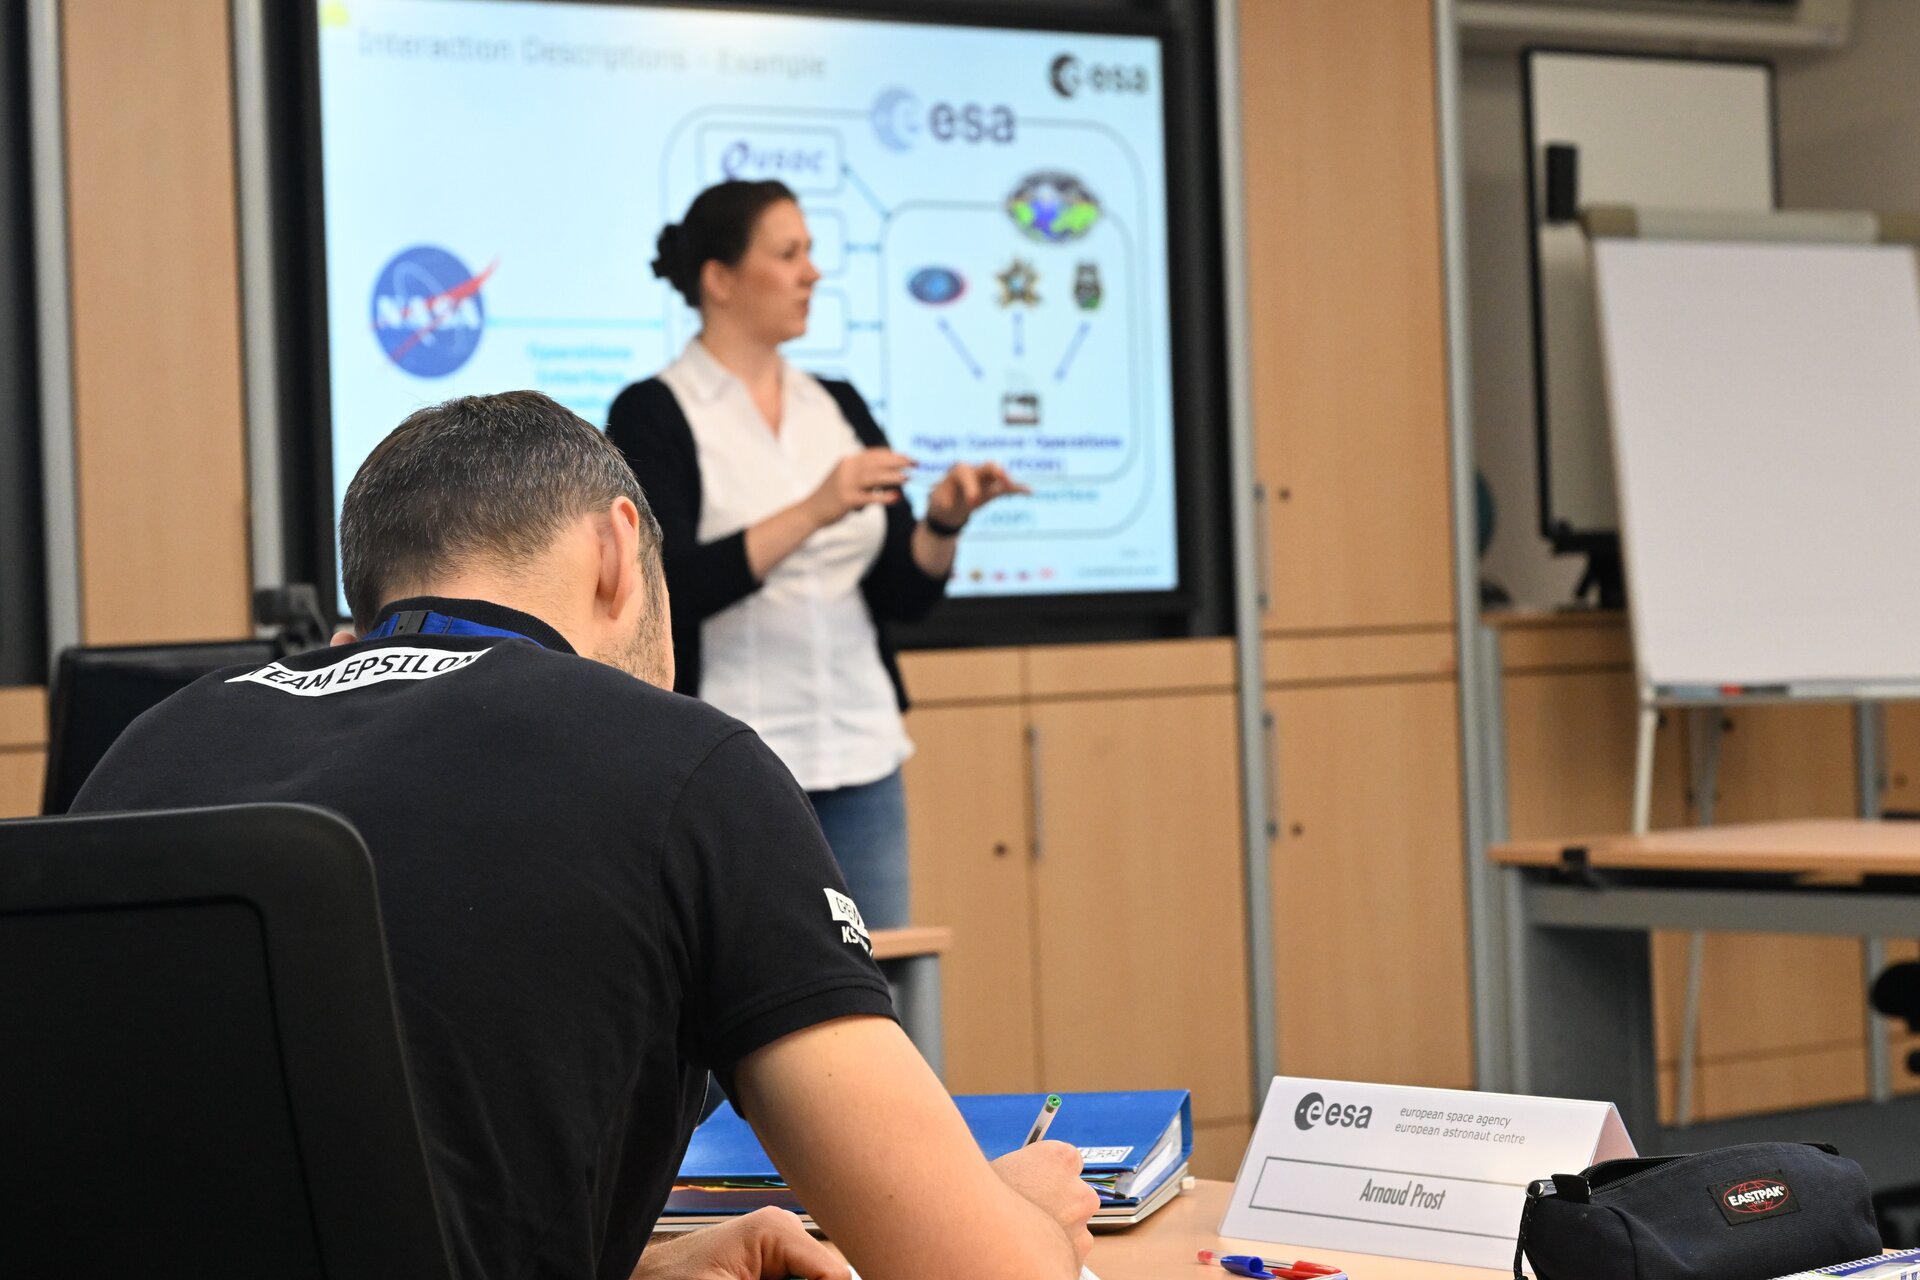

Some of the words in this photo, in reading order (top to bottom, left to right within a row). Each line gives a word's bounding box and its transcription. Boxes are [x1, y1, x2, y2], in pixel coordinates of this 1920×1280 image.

[1088, 66, 1148, 93] esa
[926, 102, 1017, 143] esa
[377, 293, 482, 331] NASA
[249, 664, 336, 690] TEAM
[337, 652, 480, 684] EPSILON
[1324, 1102, 1374, 1130] esa
[1400, 1106, 1444, 1121] european
[1446, 1110, 1474, 1124] space
[1475, 1112, 1512, 1128] agency
[1394, 1121, 1440, 1136] european
[1442, 1126, 1491, 1142] astronaut
[1492, 1131, 1526, 1145] centre
[1358, 1178, 1412, 1206] Arnaud
[1409, 1182, 1446, 1210] Prost
